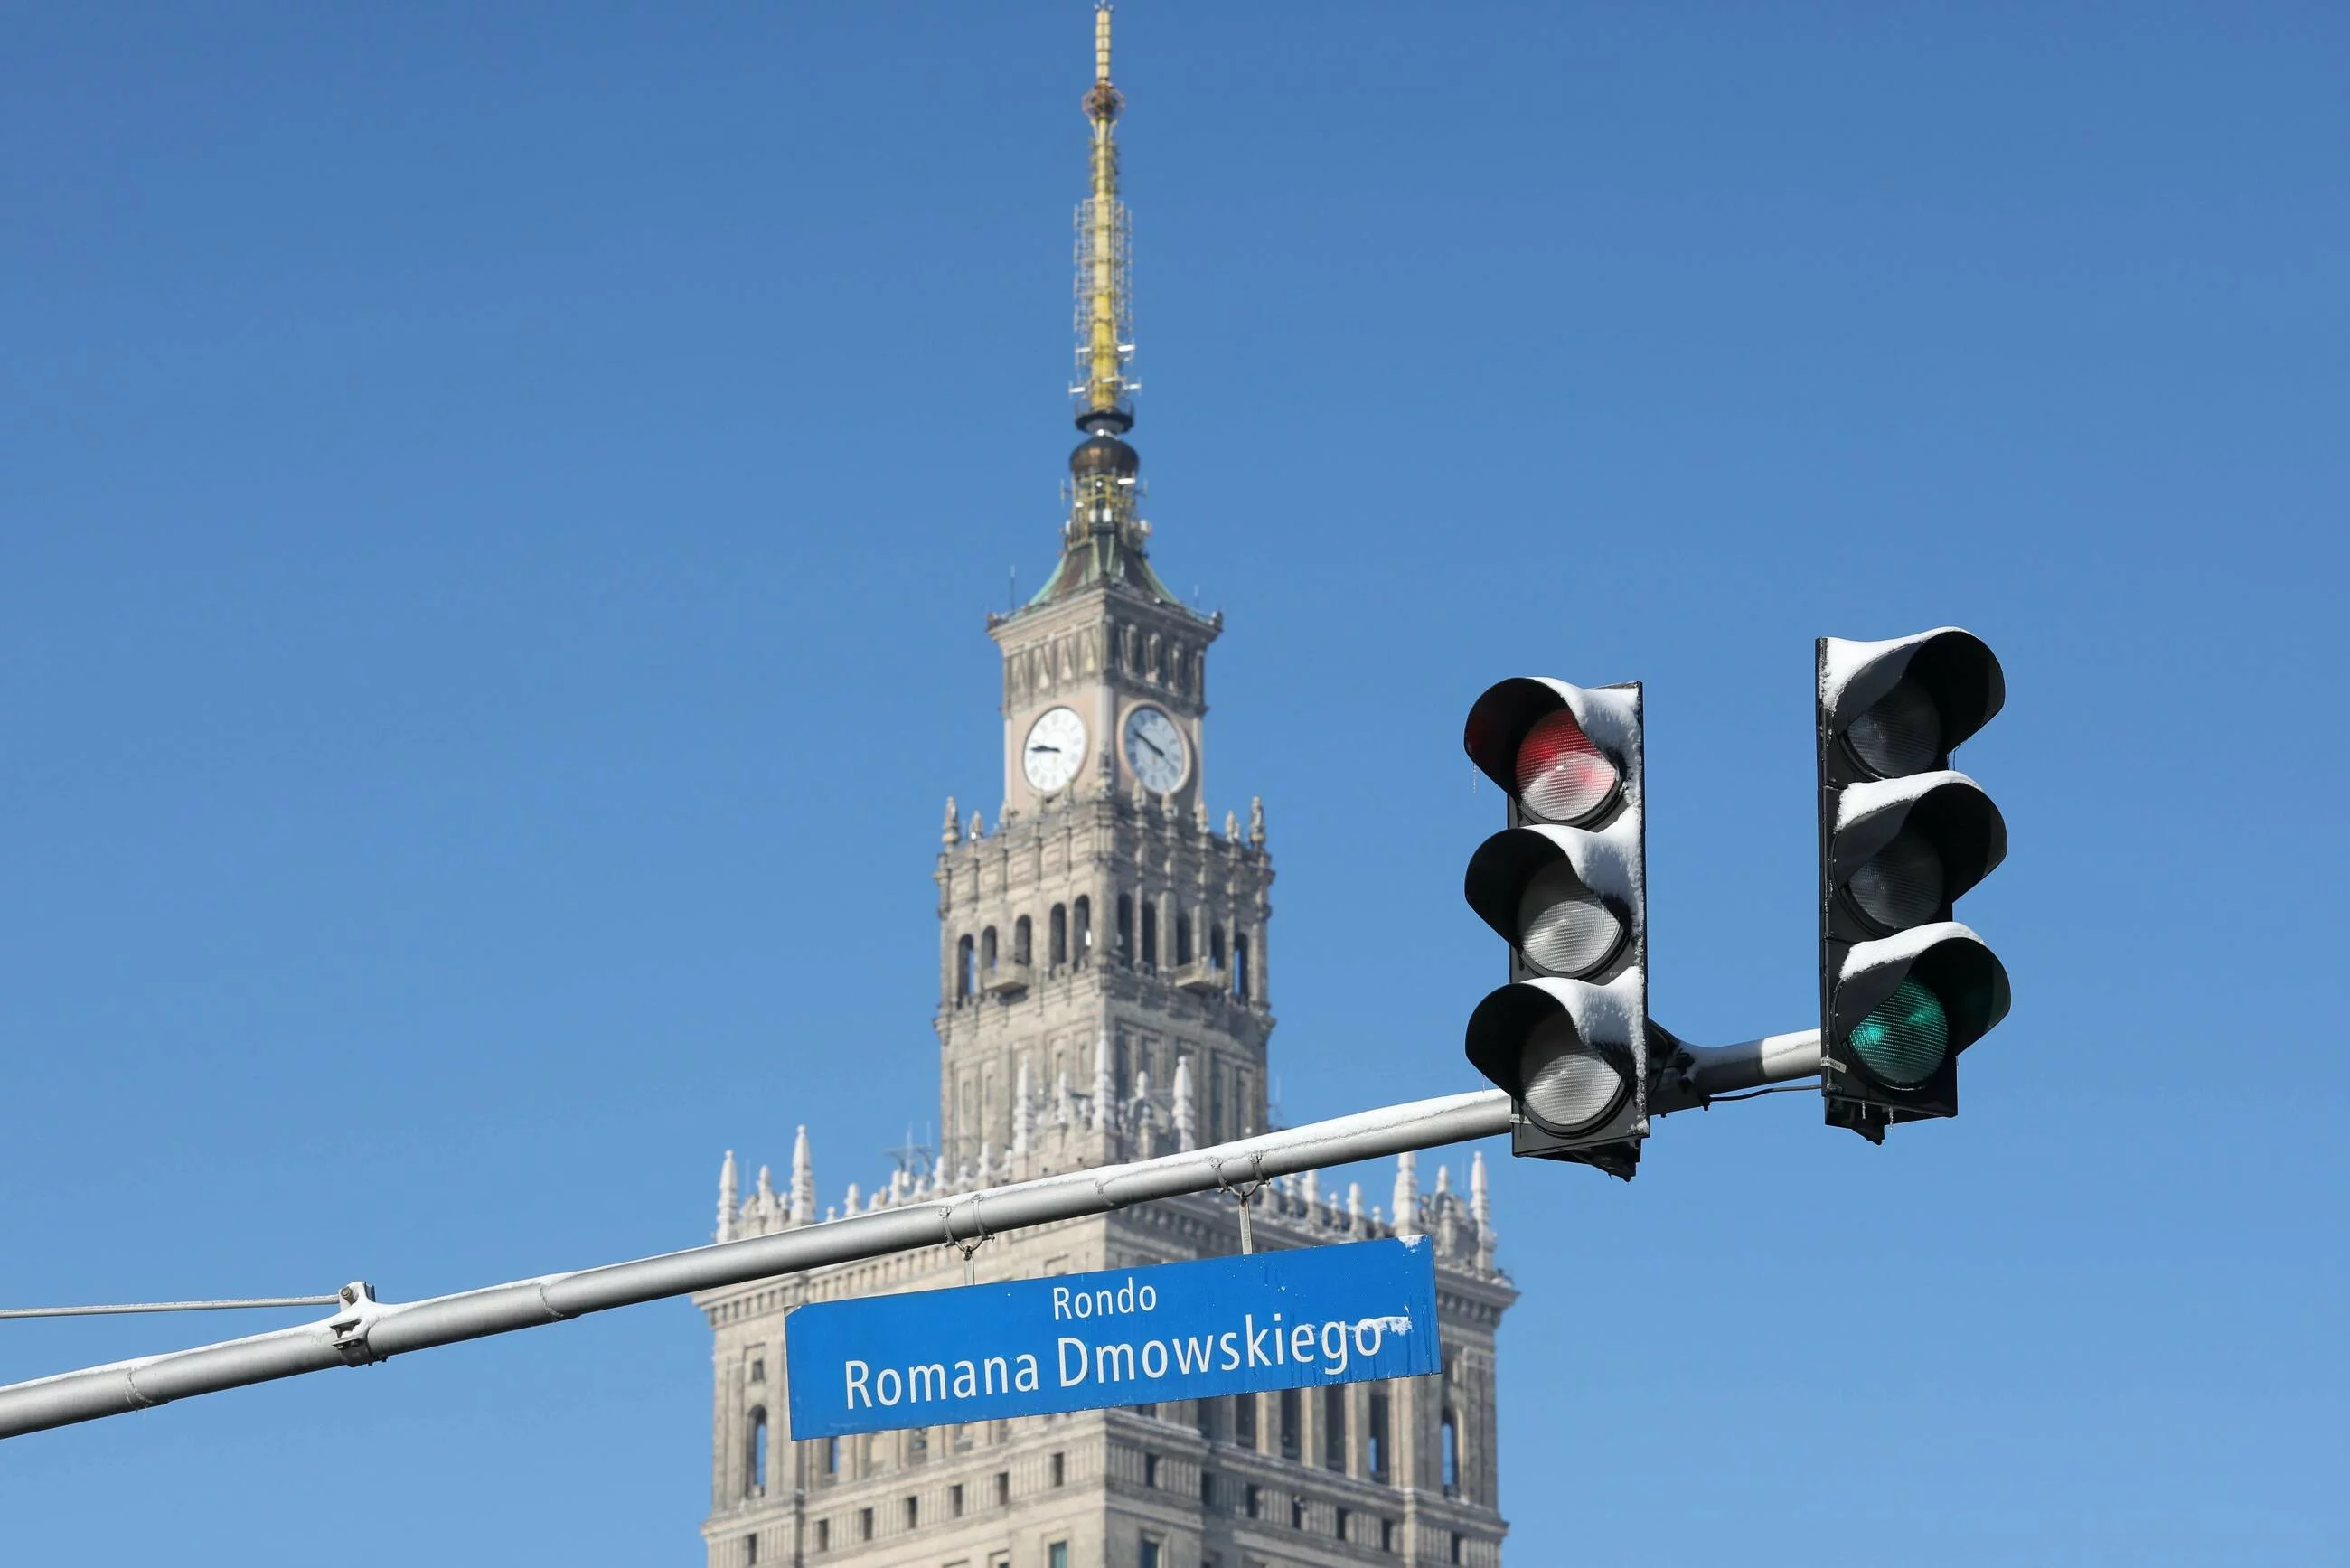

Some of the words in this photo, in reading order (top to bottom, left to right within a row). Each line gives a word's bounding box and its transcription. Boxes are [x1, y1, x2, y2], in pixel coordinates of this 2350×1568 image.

[1053, 1276, 1157, 1320] Rondo
[845, 1353, 1039, 1410] Romana
[1058, 1313, 1382, 1387] Dmowskiego
